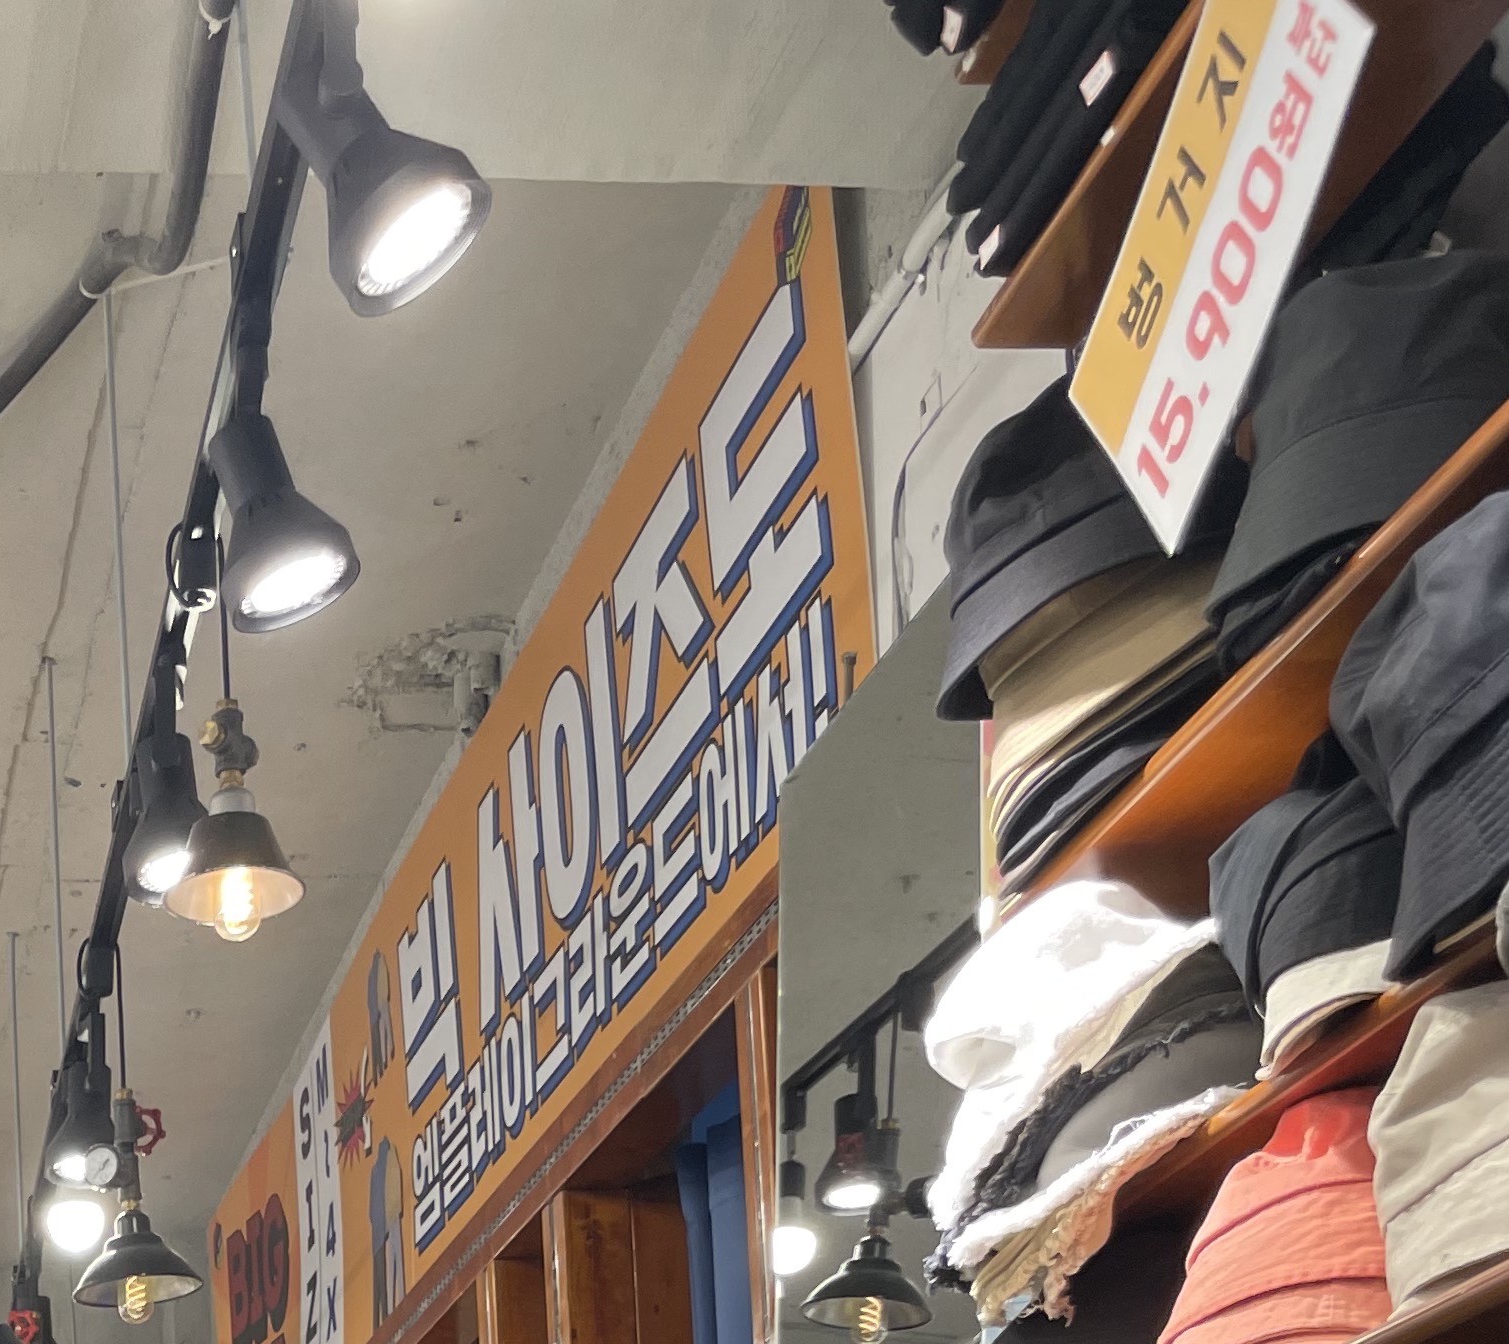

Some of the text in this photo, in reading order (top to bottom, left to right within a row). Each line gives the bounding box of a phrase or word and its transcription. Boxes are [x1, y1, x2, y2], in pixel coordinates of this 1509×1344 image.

[1136, 67, 1314, 499] 15.900원
[397, 279, 834, 1114] 빅 사이즈도
